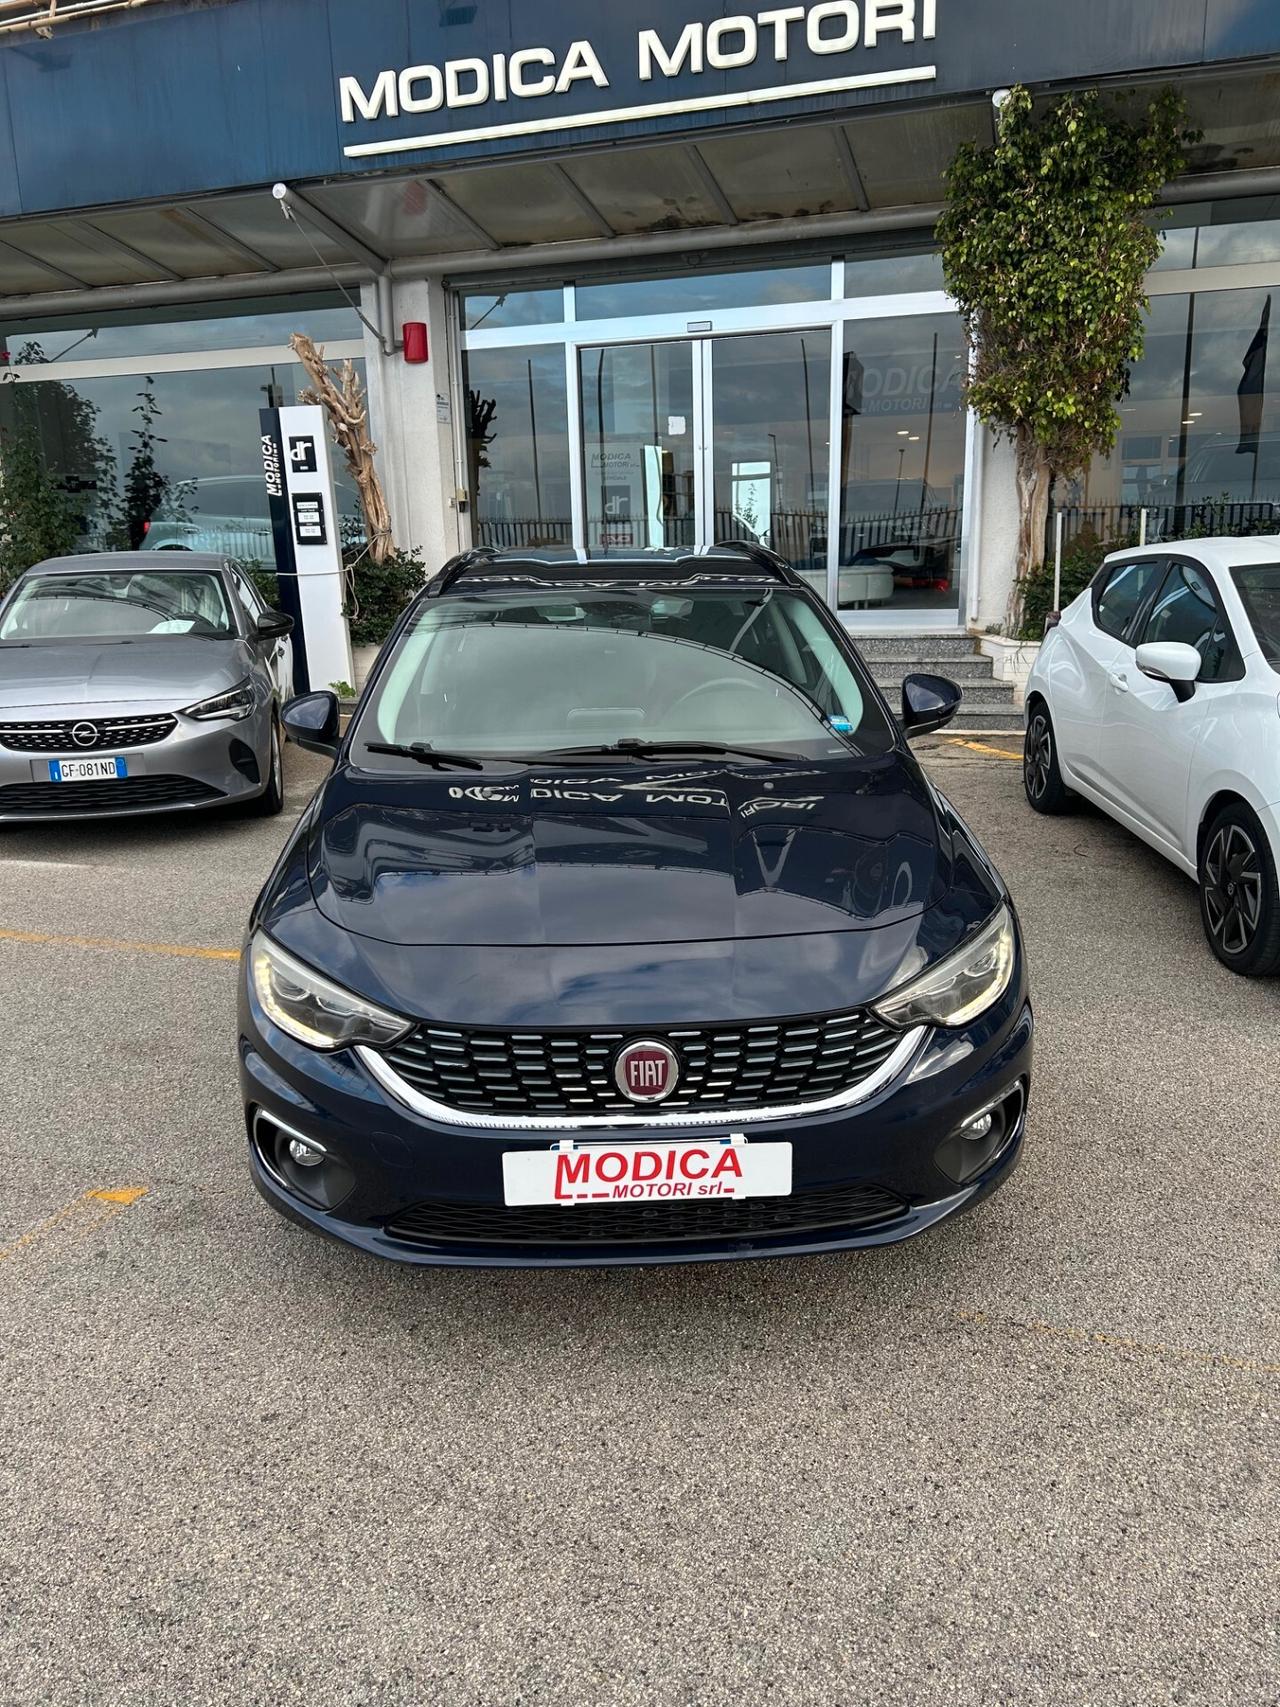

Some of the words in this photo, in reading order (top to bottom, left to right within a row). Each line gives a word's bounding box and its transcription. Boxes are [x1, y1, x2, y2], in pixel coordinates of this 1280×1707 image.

[339, 40, 610, 123] MODICA
[639, 0, 936, 81] MOTORI
[852, 364, 962, 398] ODICA
[261, 434, 276, 496] MODICA
[290, 440, 313, 461] dr
[630, 1060, 666, 1087] FIAT
[556, 1148, 743, 1191] MODICA
[612, 1182, 693, 1198] MOTORI
[697, 1180, 723, 1196] srl
